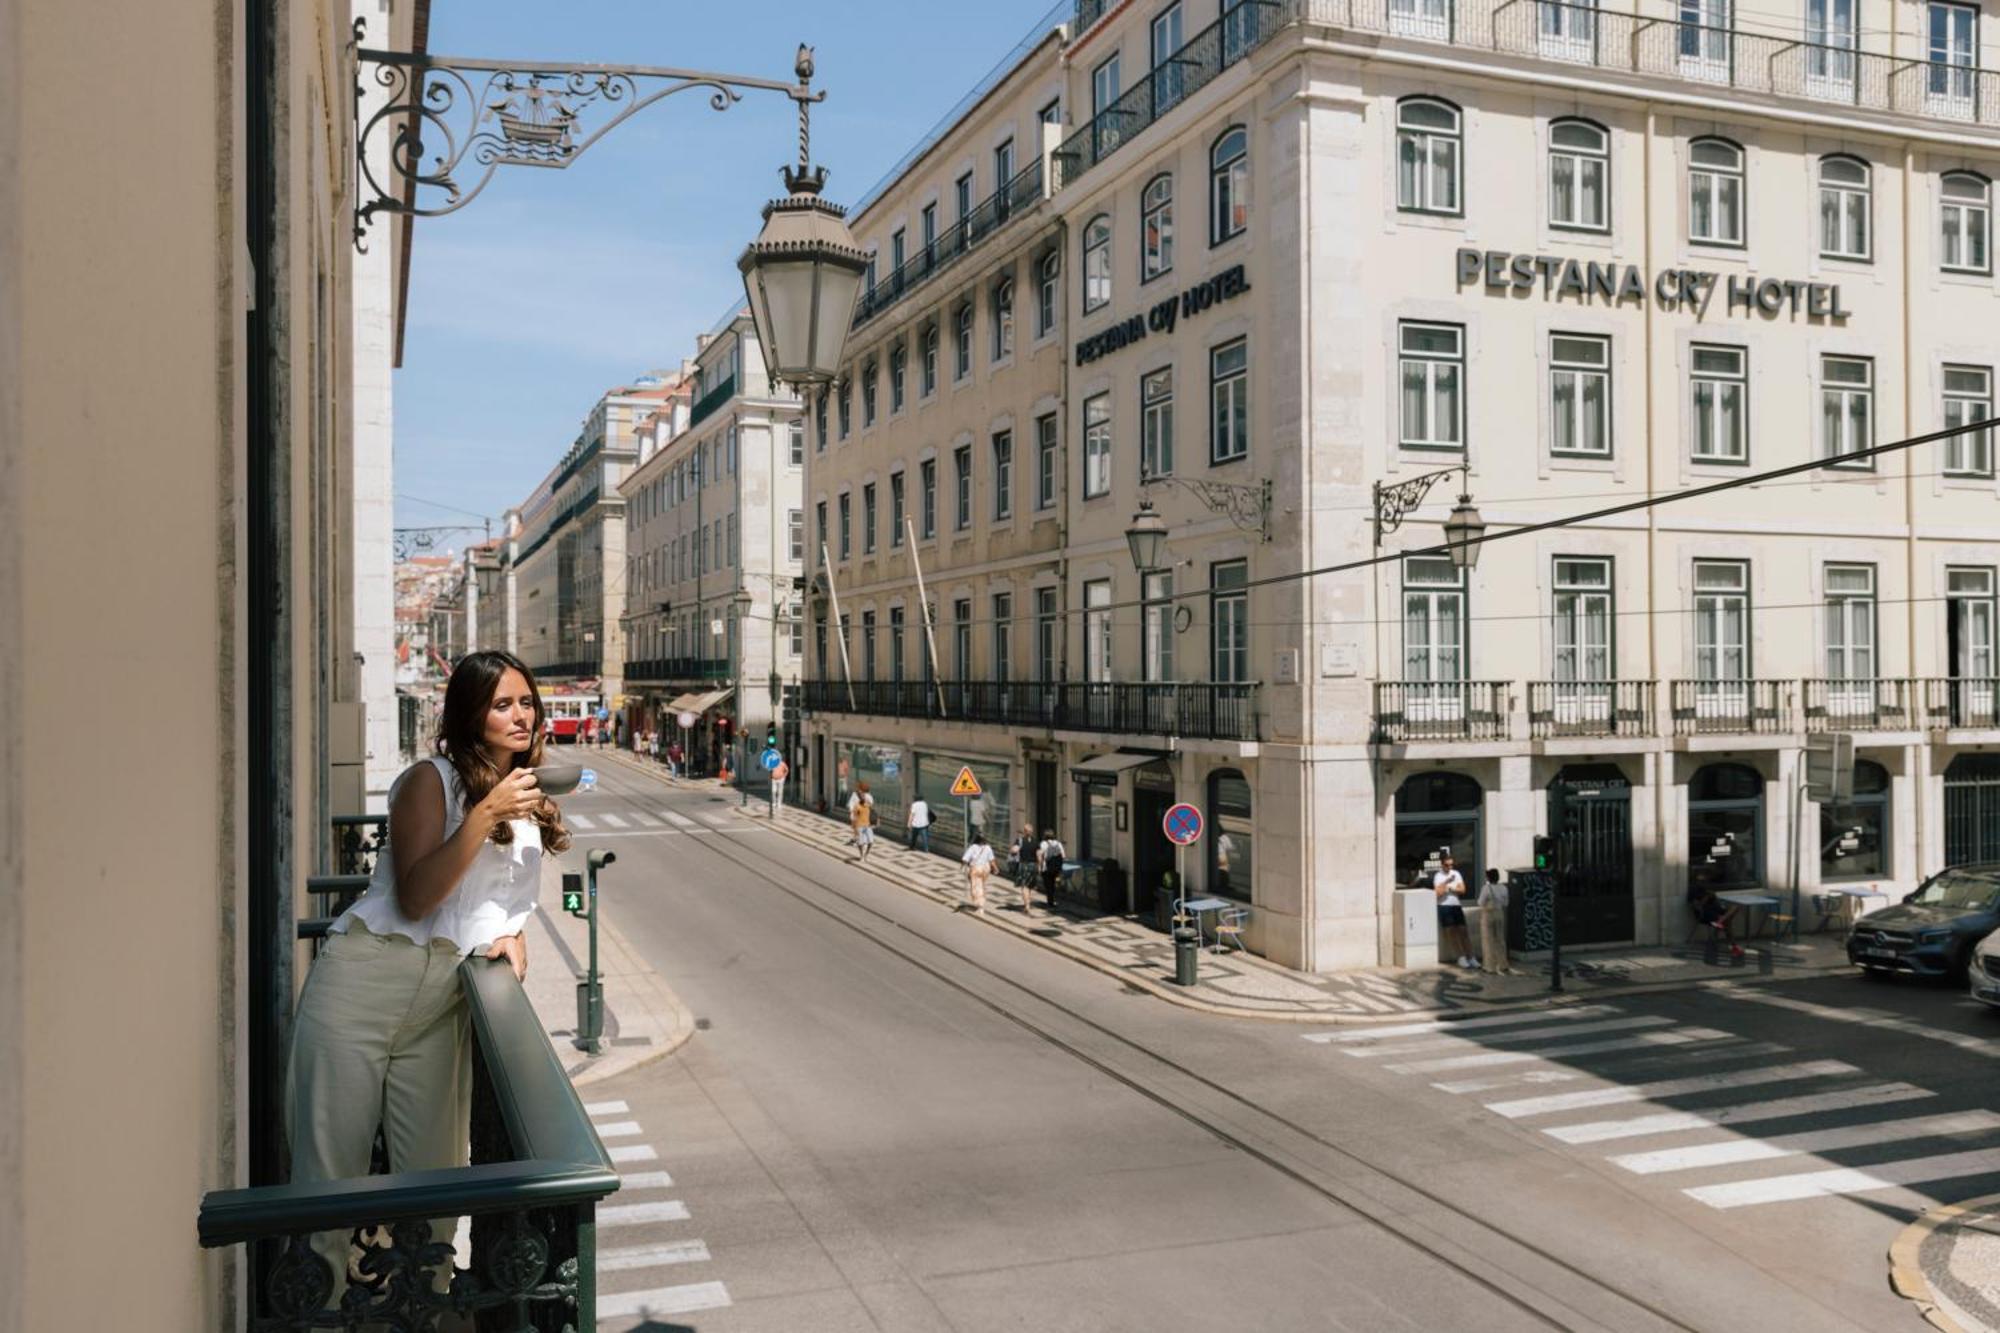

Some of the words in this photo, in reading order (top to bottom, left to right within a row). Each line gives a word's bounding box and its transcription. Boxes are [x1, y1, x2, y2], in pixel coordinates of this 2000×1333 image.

[1076, 314, 1147, 367] PESTANA
[1182, 264, 1251, 319] HOTEL
[1456, 248, 1646, 302] PESTANA
[1656, 269, 1720, 324] CR7
[1728, 275, 1852, 320] HOTEL
